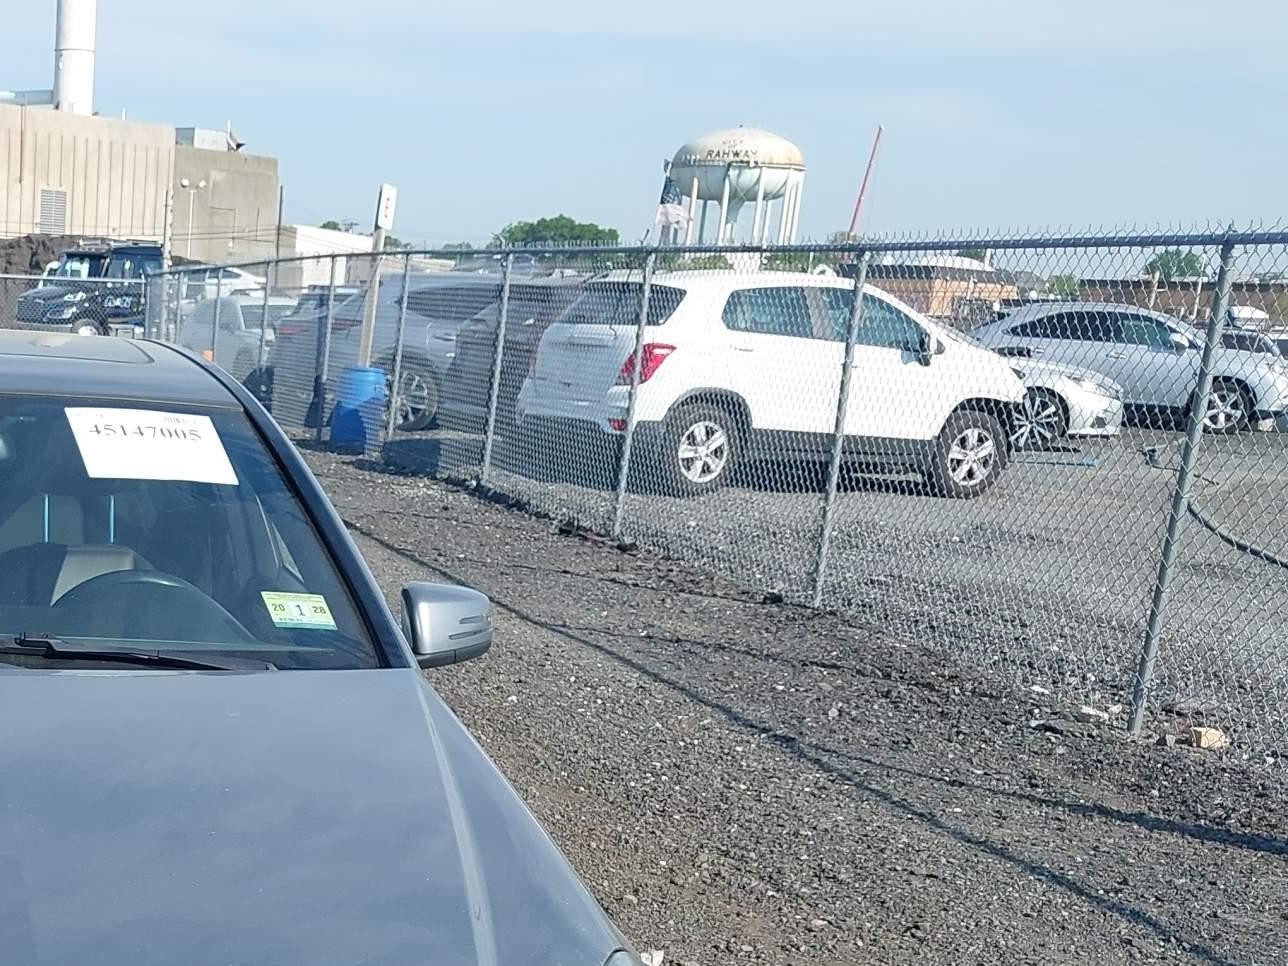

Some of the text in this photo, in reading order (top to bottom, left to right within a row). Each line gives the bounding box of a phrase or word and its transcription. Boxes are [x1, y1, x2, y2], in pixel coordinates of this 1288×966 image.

[706, 150, 758, 159] RAHWAY
[89, 423, 202, 442] 45147005
[272, 603, 327, 617] 20 1 28
